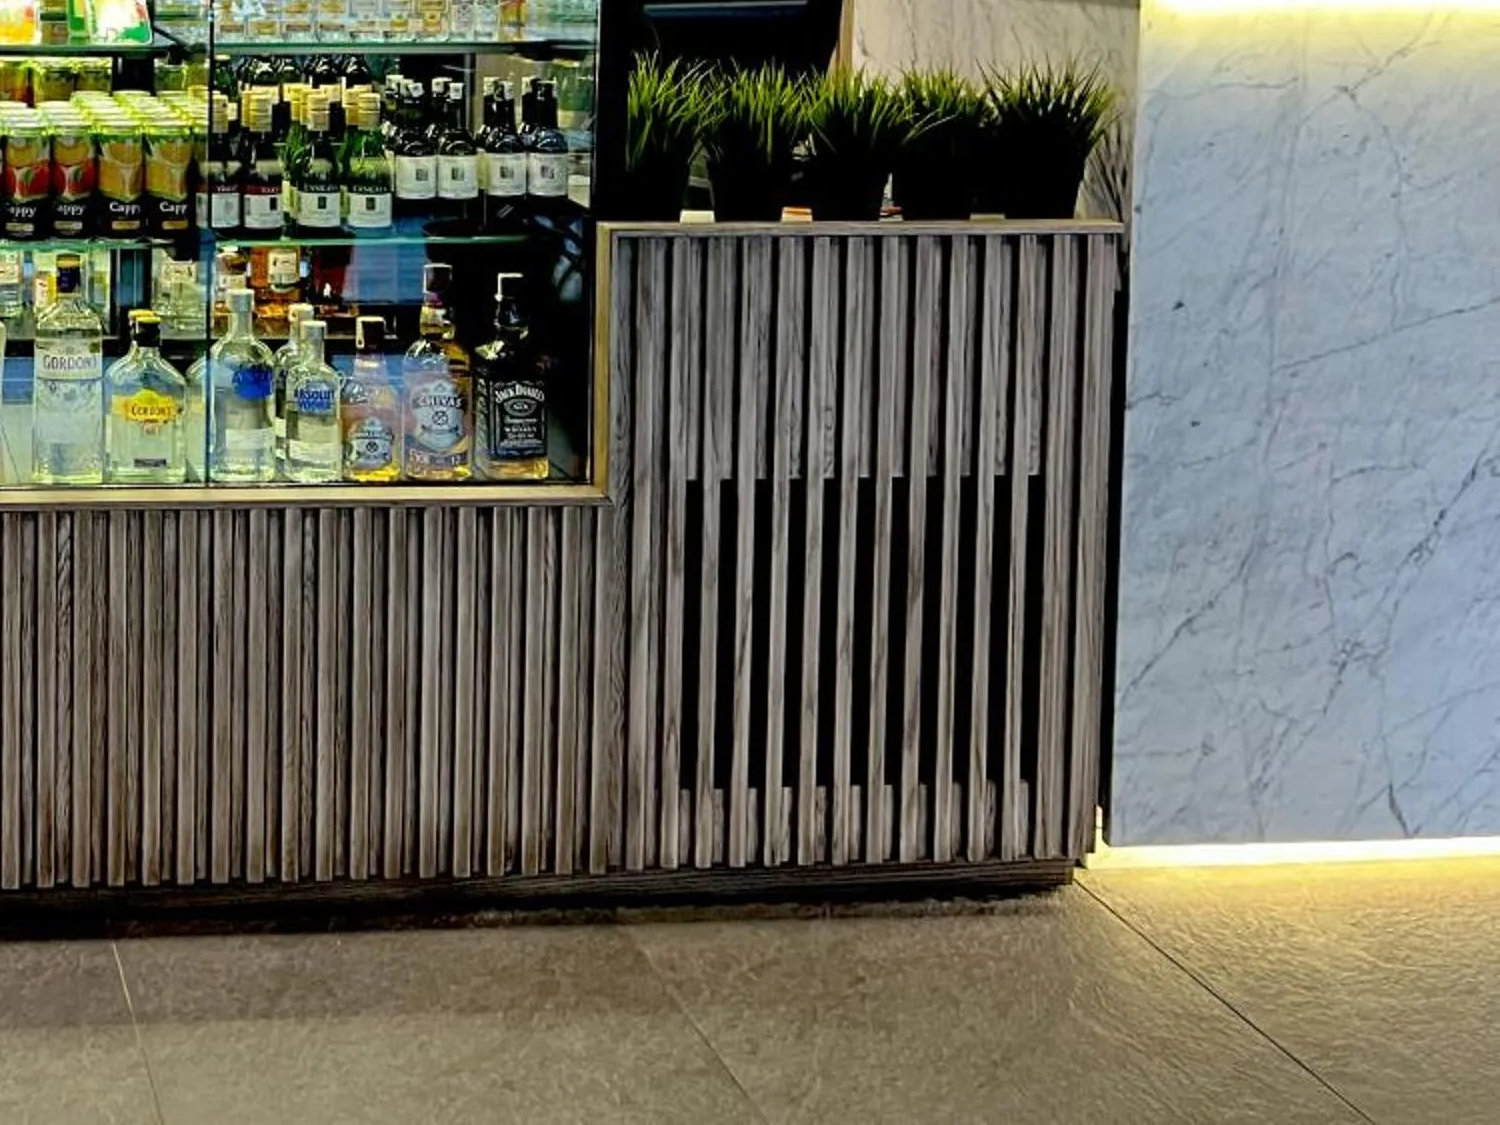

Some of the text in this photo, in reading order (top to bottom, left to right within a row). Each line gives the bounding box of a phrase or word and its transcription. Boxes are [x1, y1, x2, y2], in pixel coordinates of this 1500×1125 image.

[7, 206, 37, 219] appy
[55, 203, 84, 217] appy
[109, 201, 141, 217] Capp
